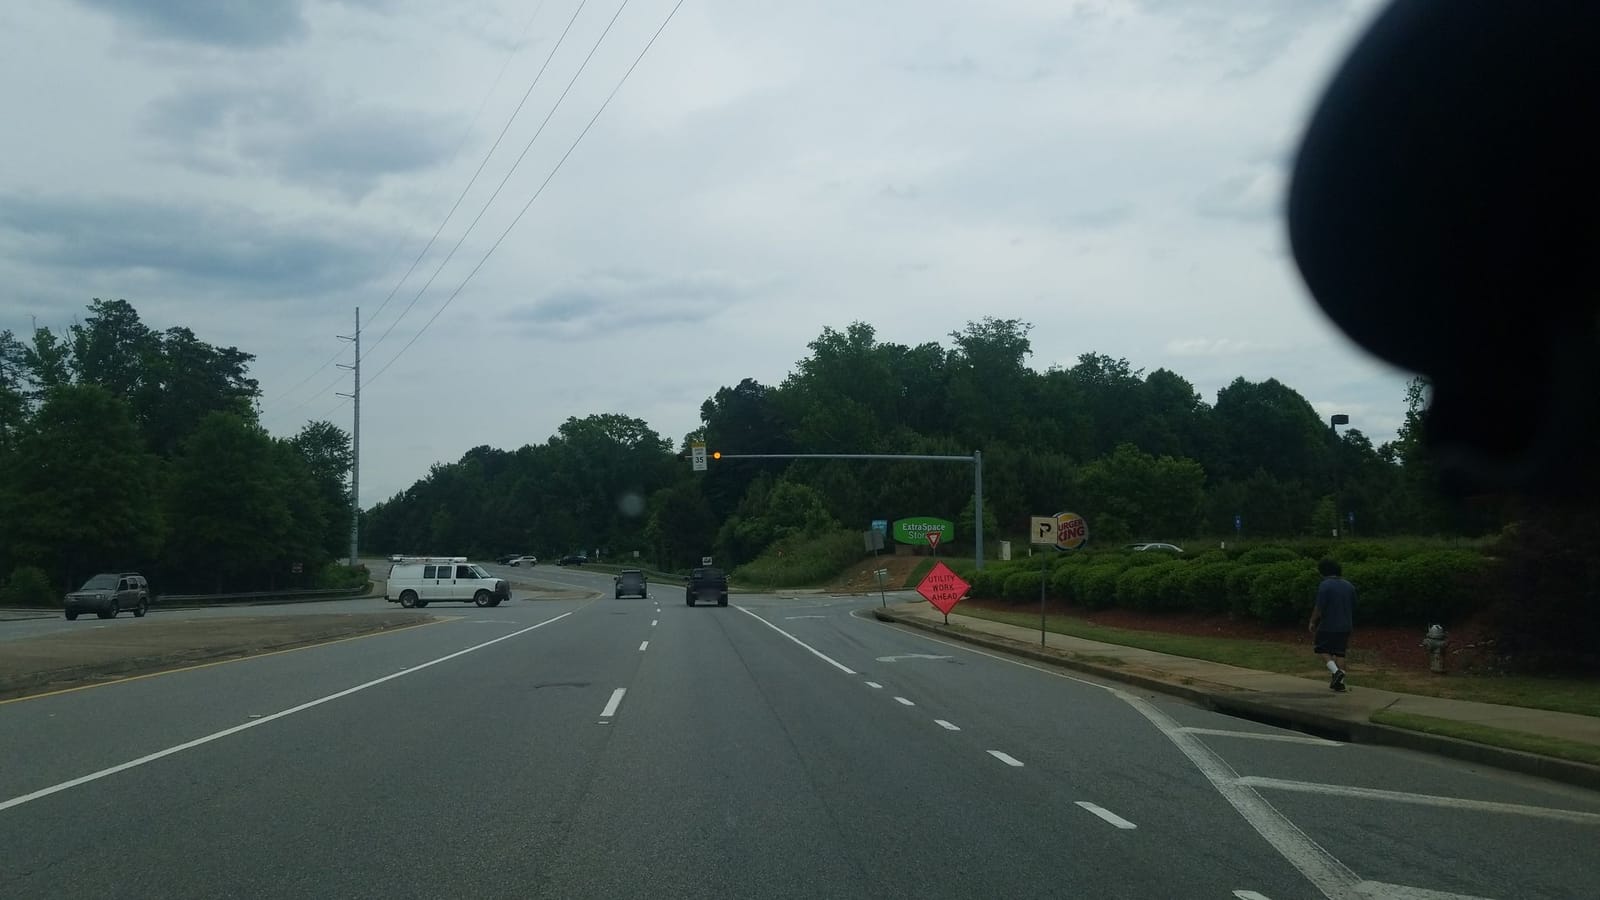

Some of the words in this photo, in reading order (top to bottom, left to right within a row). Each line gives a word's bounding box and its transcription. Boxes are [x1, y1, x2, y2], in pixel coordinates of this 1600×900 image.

[695, 456, 704, 464] 35
[902, 523, 946, 532] ExtraSpace
[928, 574, 955, 583] UTILITY
[932, 583, 954, 592] WORK
[932, 592, 958, 601] AHEAD
